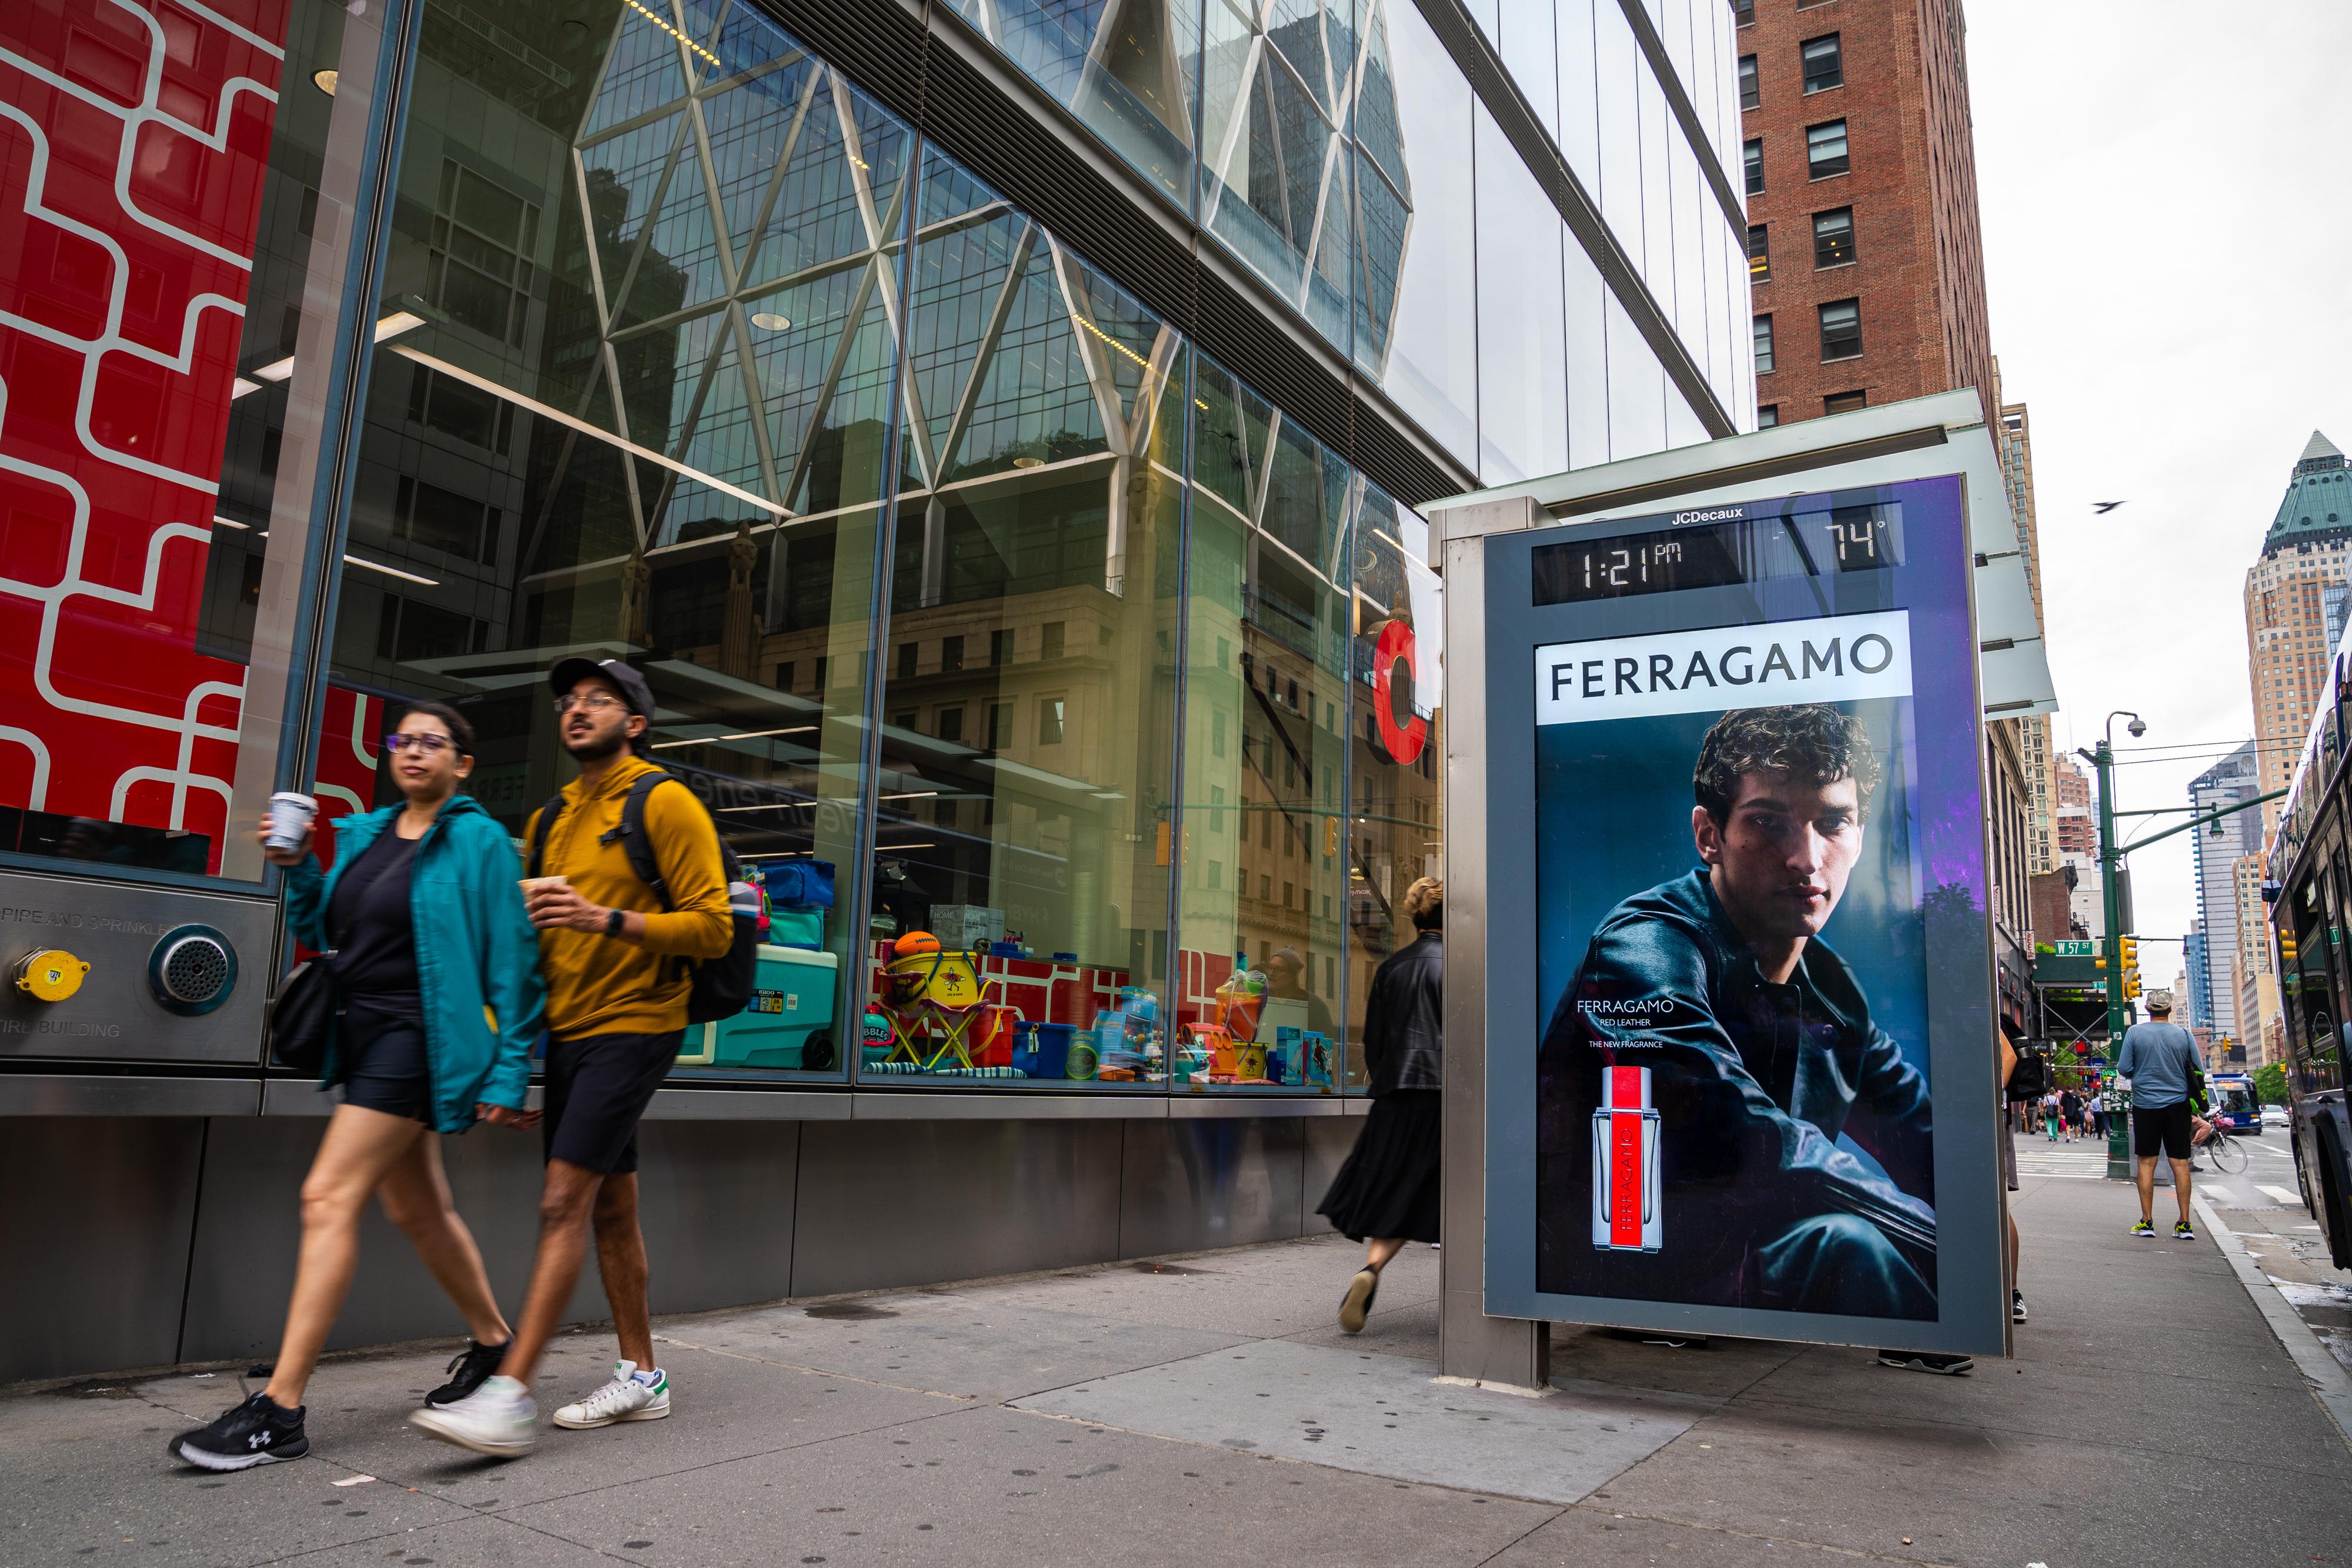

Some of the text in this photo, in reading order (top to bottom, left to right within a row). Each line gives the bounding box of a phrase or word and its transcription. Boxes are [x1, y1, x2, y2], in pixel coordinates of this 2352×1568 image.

[1672, 507, 1743, 526] JCDecaux
[1583, 547, 1648, 589] 1:21
[1551, 633, 1894, 701] FERRAGAMO
[1, 907, 43, 924] PIPE
[46, 912, 83, 928] AND
[2057, 942, 2065, 954] W
[2068, 942, 2079, 954] 57
[1577, 1000, 1674, 1014] FERRAGAMO
[38, 1021, 120, 1037] BUILDING
[1617, 1018, 1651, 1027] LEATHER
[1619, 1128, 1633, 1231] FERRAGAMO
